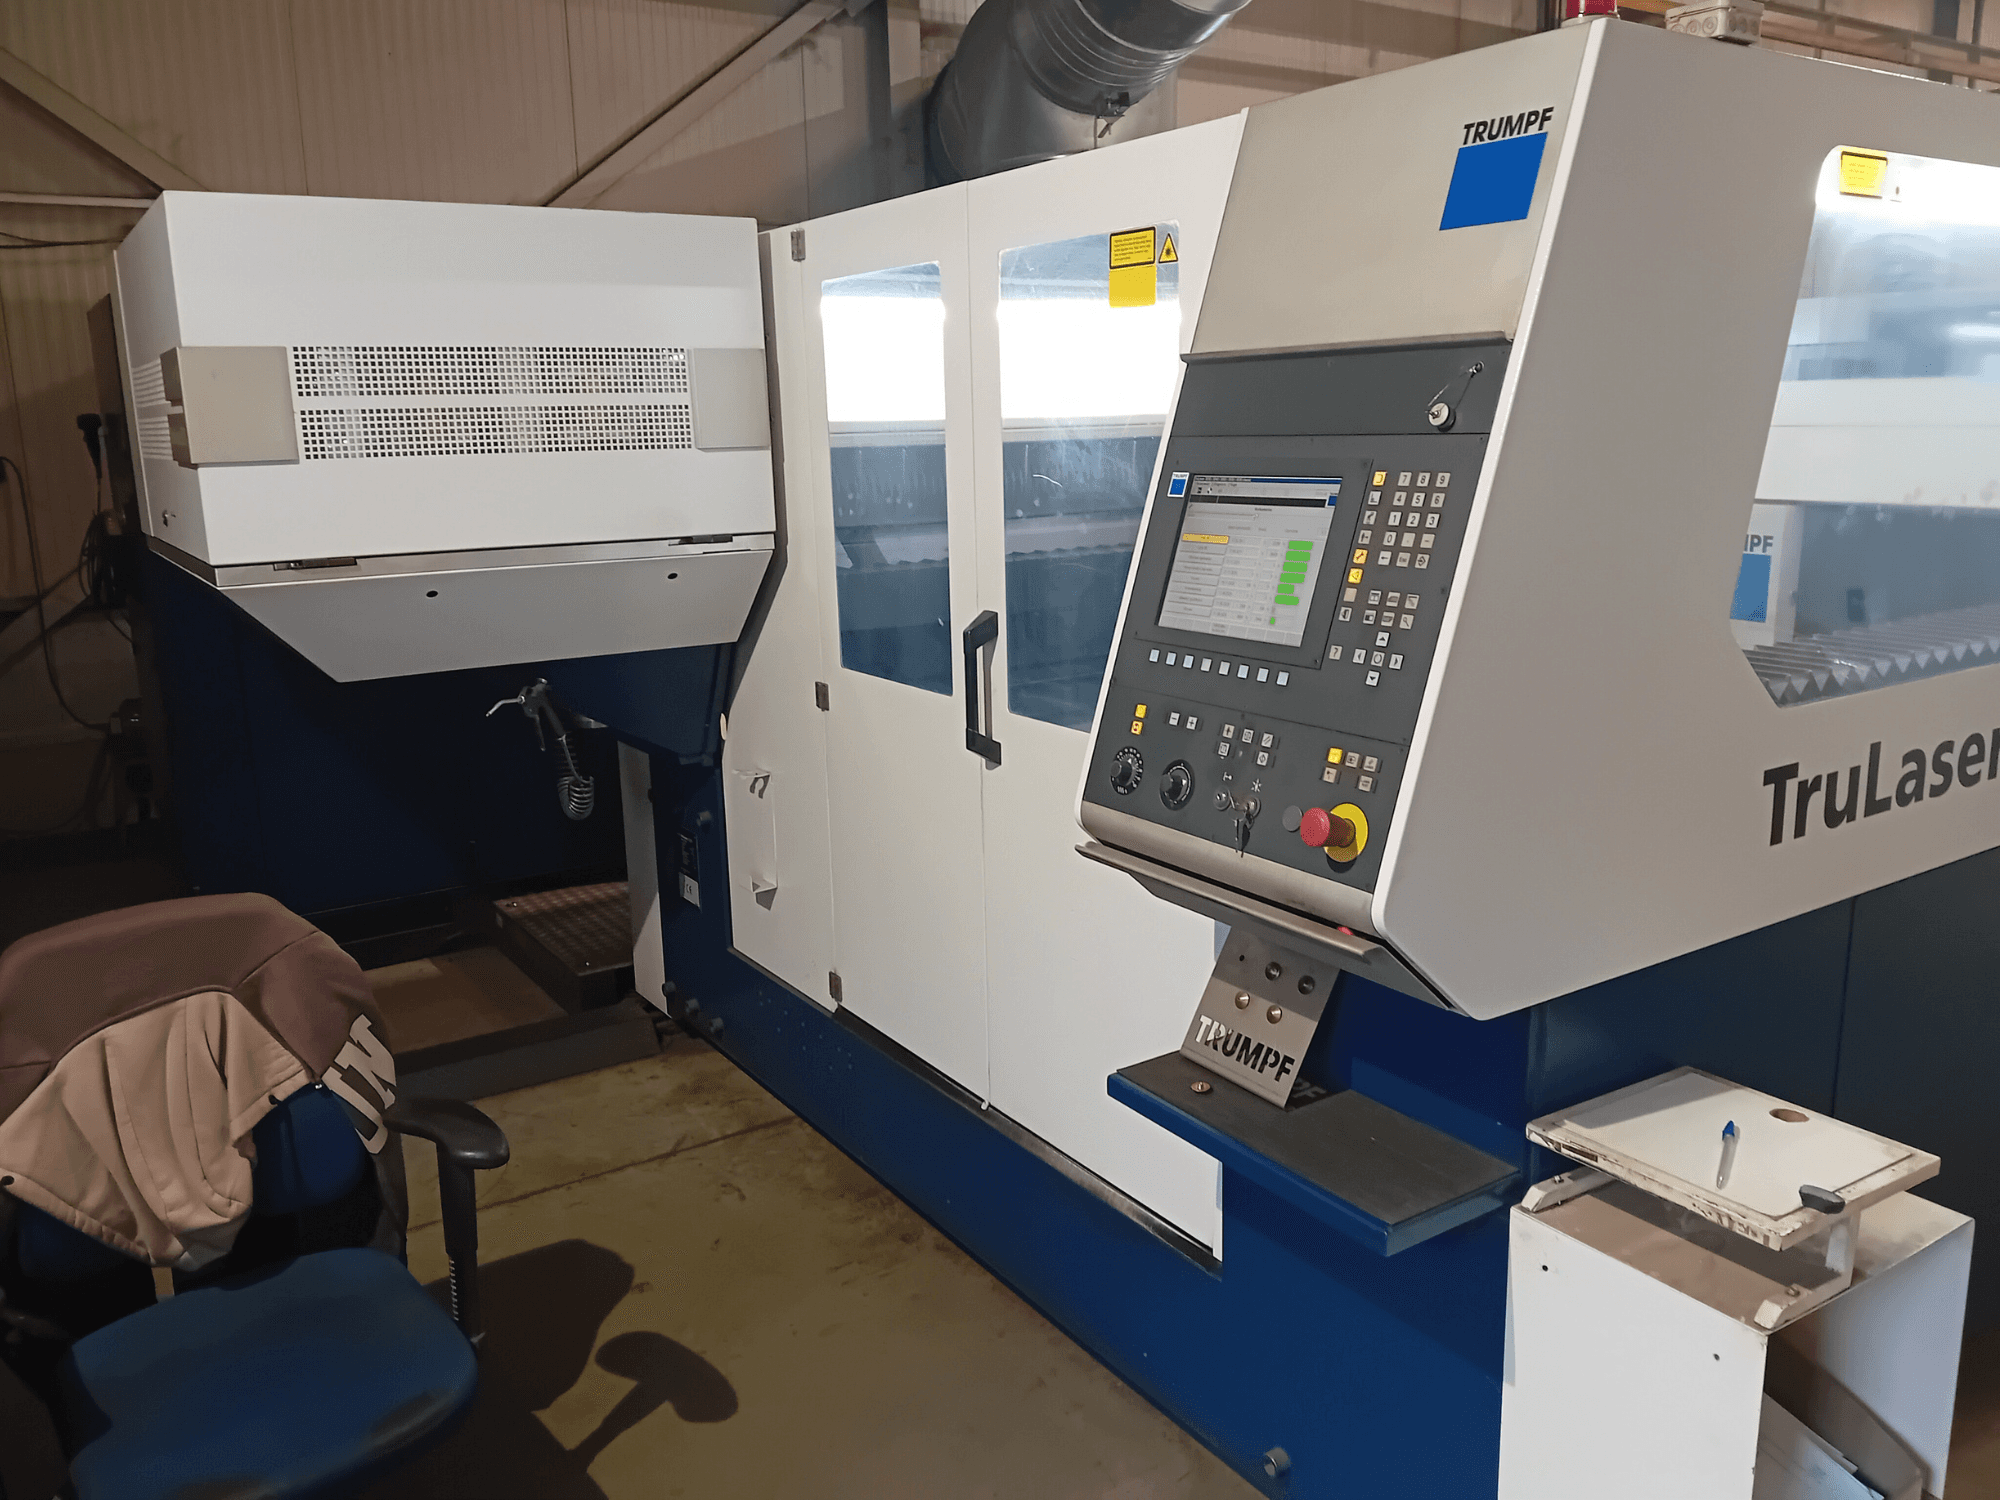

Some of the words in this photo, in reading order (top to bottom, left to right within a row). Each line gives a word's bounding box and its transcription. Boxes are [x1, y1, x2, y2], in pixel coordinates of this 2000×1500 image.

[1462, 106, 1555, 146] TRUMPF
[1420, 474, 1427, 485] 8
[1439, 474, 1446, 485] 9
[1414, 494, 1421, 504] 5
[1434, 495, 1441, 505] 6
[1410, 515, 1417, 525] 2
[1428, 516, 1436, 526] 3
[1763, 727, 2000, 847] TruLaser
[1195, 1014, 1296, 1083] TRUMPF
